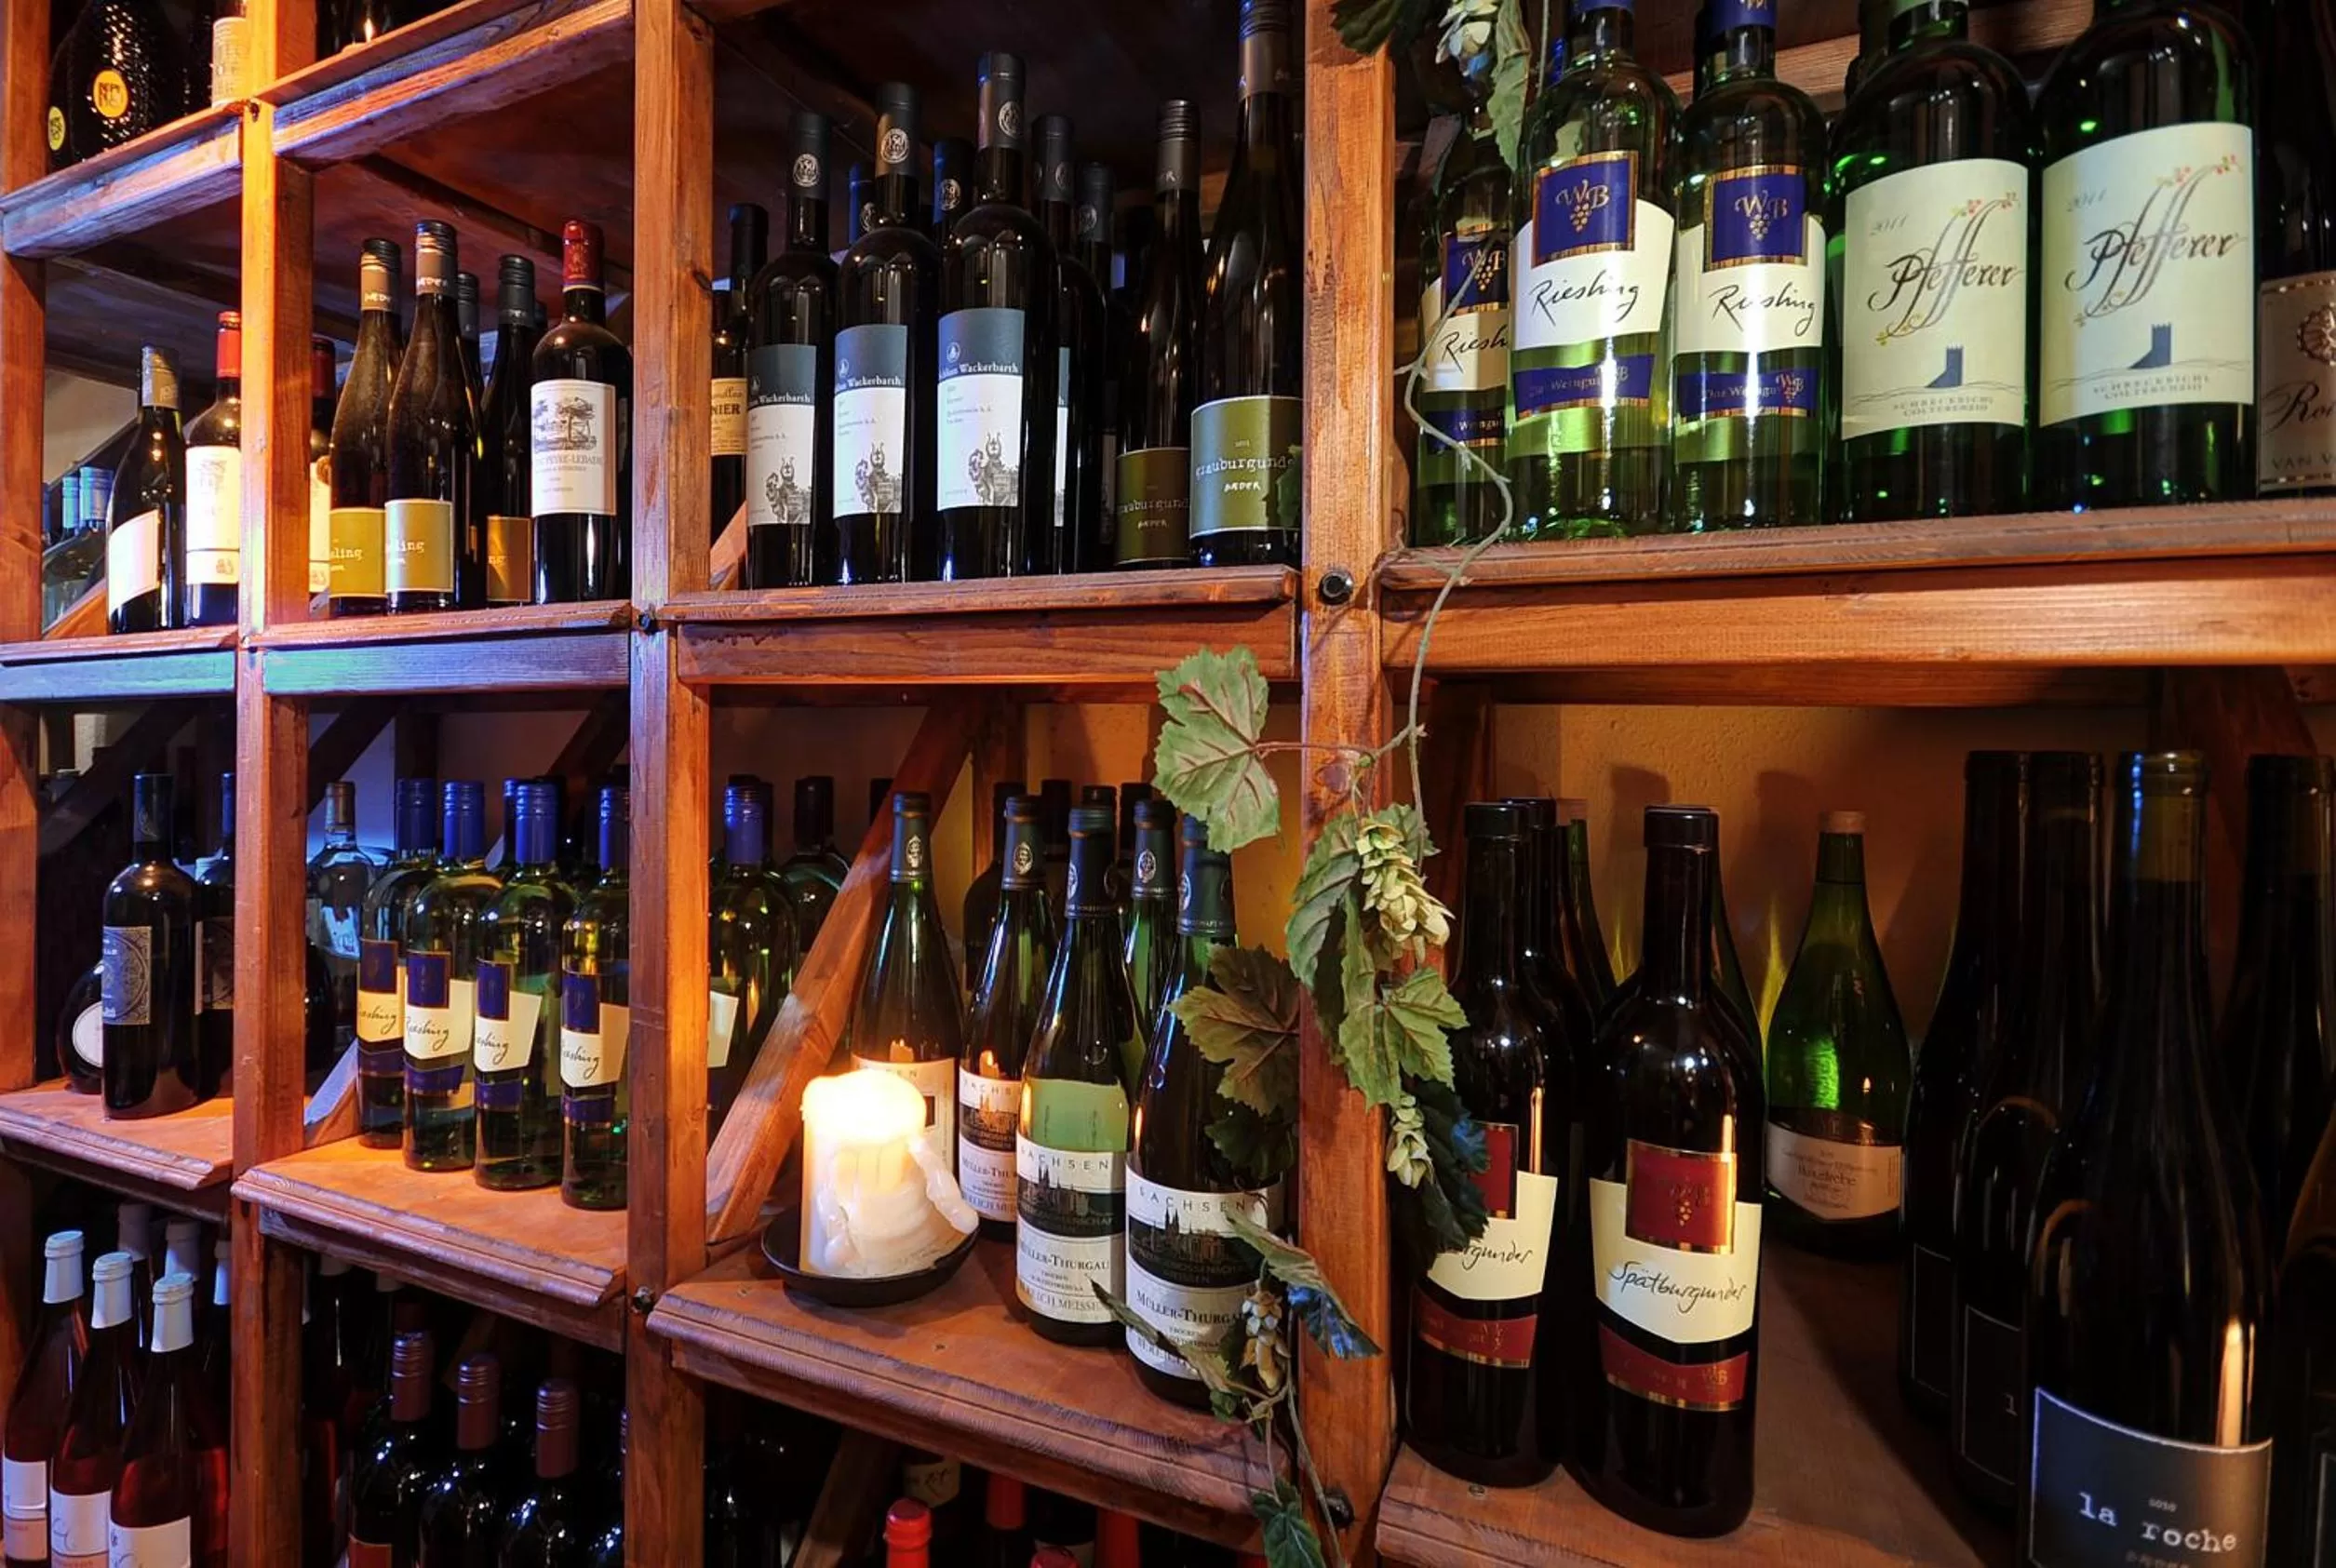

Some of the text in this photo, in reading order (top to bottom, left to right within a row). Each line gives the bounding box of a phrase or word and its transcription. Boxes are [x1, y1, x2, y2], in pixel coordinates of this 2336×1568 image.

[1555, 178, 1609, 209] WB
[1734, 190, 1788, 217] WB
[2064, 165, 2247, 317] Pfefferer
[1868, 202, 2024, 338] Pfefferer
[1707, 282, 1816, 336] Risling
[960, 361, 1020, 373] Wackerbarth
[1020, 1146, 1109, 1171] SACHSEN
[1139, 1186, 1246, 1213] SACHSEN
[1606, 1260, 1748, 1314] Spätburgunder
[2078, 1491, 2237, 1553] la roche
